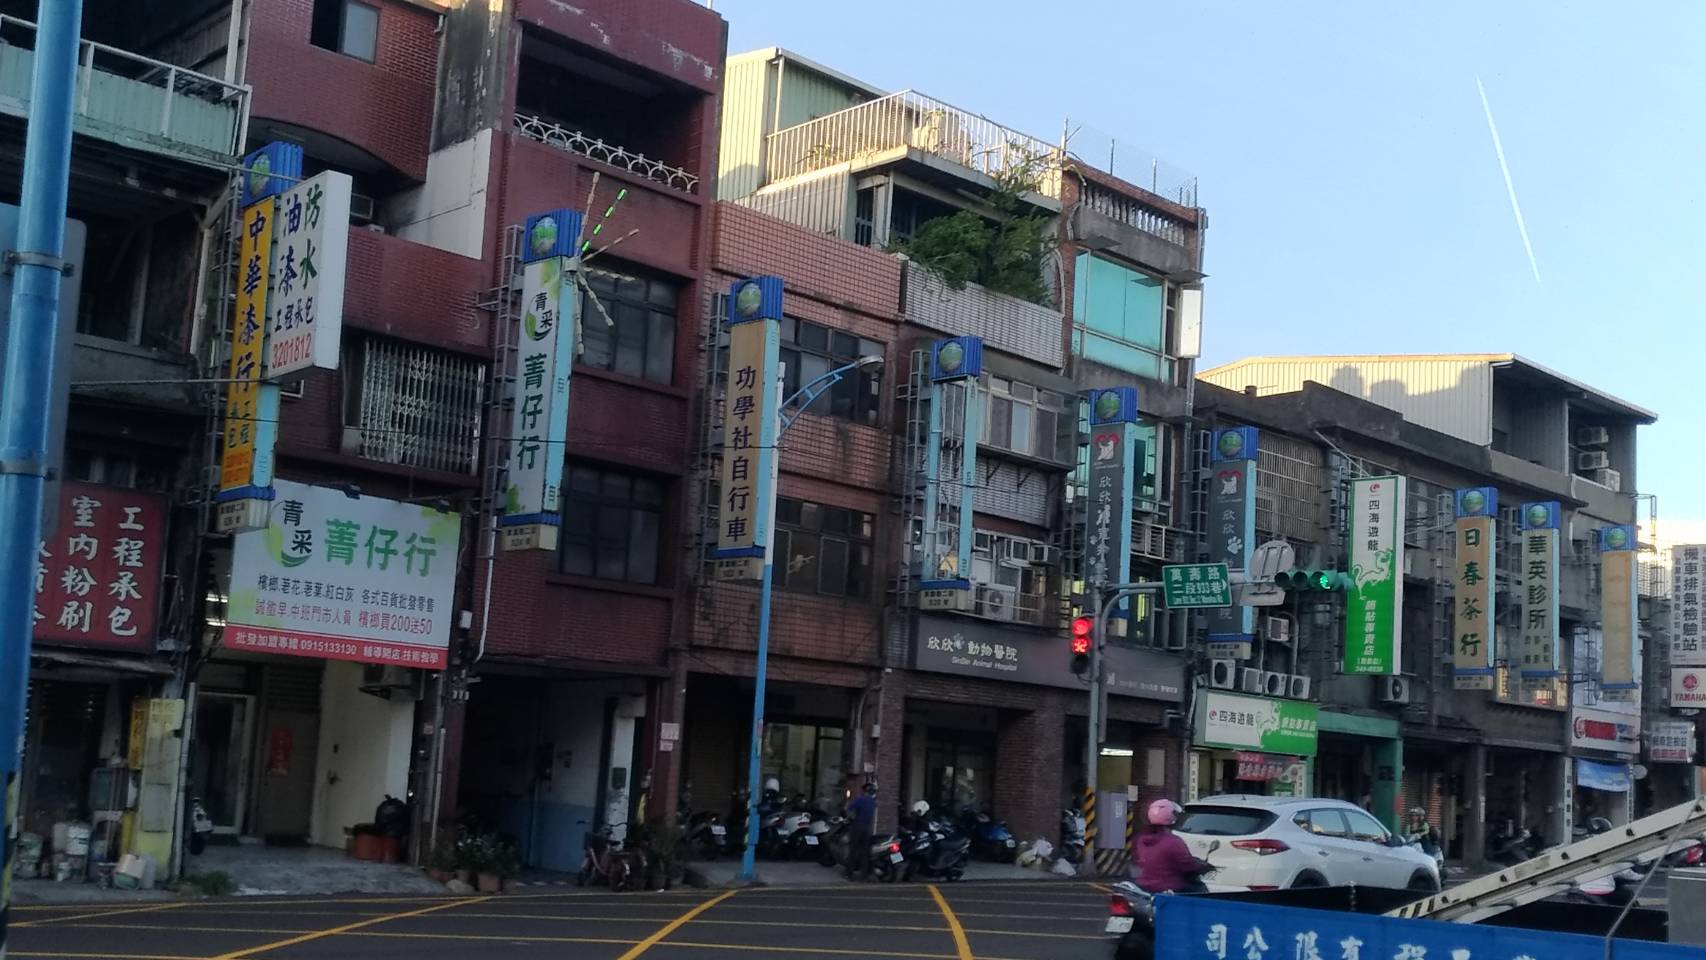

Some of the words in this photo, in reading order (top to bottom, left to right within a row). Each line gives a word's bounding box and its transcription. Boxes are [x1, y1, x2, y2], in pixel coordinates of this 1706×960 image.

[278, 193, 302, 298] 油漆
[299, 184, 323, 290] 防水
[235, 210, 267, 394] 中華漆行
[271, 332, 312, 369] 3201812
[274, 295, 314, 332] 工程承包
[516, 352, 547, 471] 菁仔行
[725, 364, 757, 543] 功學社自行車
[56, 495, 102, 633] 室內粉刷
[107, 506, 145, 637] 工程承包
[283, 500, 313, 555] 青采
[324, 517, 438, 578] 菁仔行
[1460, 527, 1484, 658] 日春茶行
[1527, 535, 1547, 629] 華英診所
[1682, 547, 1699, 653] 機車排氣檢驗站
[300, 640, 357, 656] 0915133130
[1673, 693, 1706, 702] YAMAHA
